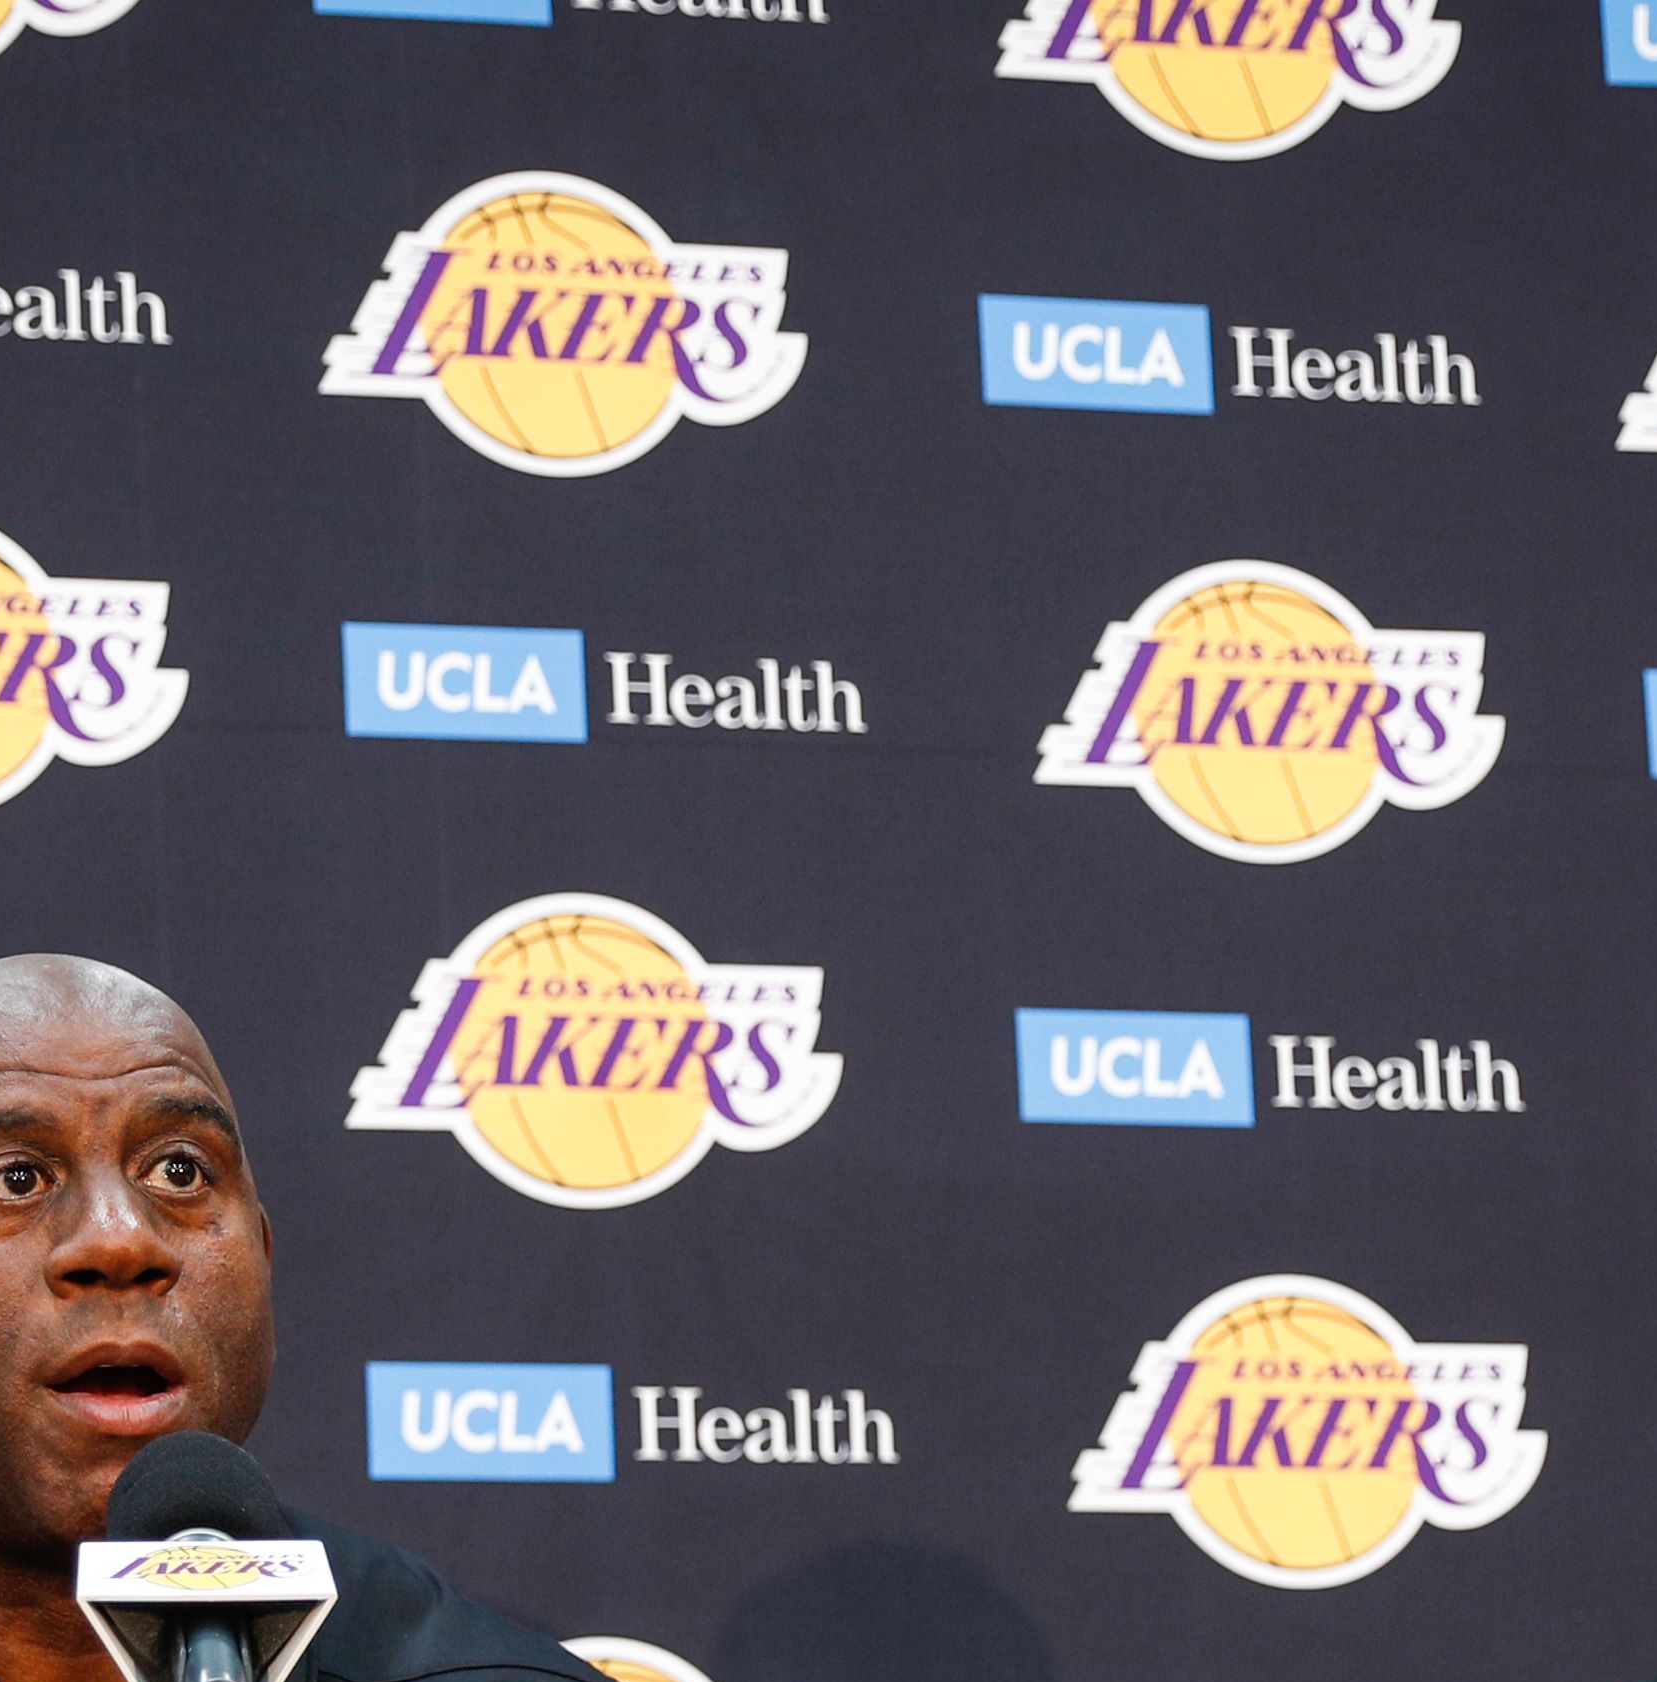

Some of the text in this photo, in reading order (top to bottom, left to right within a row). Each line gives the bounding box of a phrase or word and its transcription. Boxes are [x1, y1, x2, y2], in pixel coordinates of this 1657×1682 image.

[486, 253, 763, 282] LOS ANGELES
[370, 250, 763, 402] LAKERS
[1012, 319, 1481, 406] UCLA Health
[376, 648, 868, 734] UCLA Health
[1194, 641, 1460, 667] LOS ANGELES
[1083, 639, 1462, 786] LAKERS
[517, 977, 798, 1002] LOS ANGELES
[397, 976, 798, 1127] LAKERS
[1048, 1033, 1526, 1113] UCLA Health
[1232, 1358, 1502, 1380] LOS ANGELES
[399, 1386, 900, 1465] UCLA Health
[1118, 1358, 1503, 1505] LAKERS
[110, 1557, 305, 1579] LAKERS
